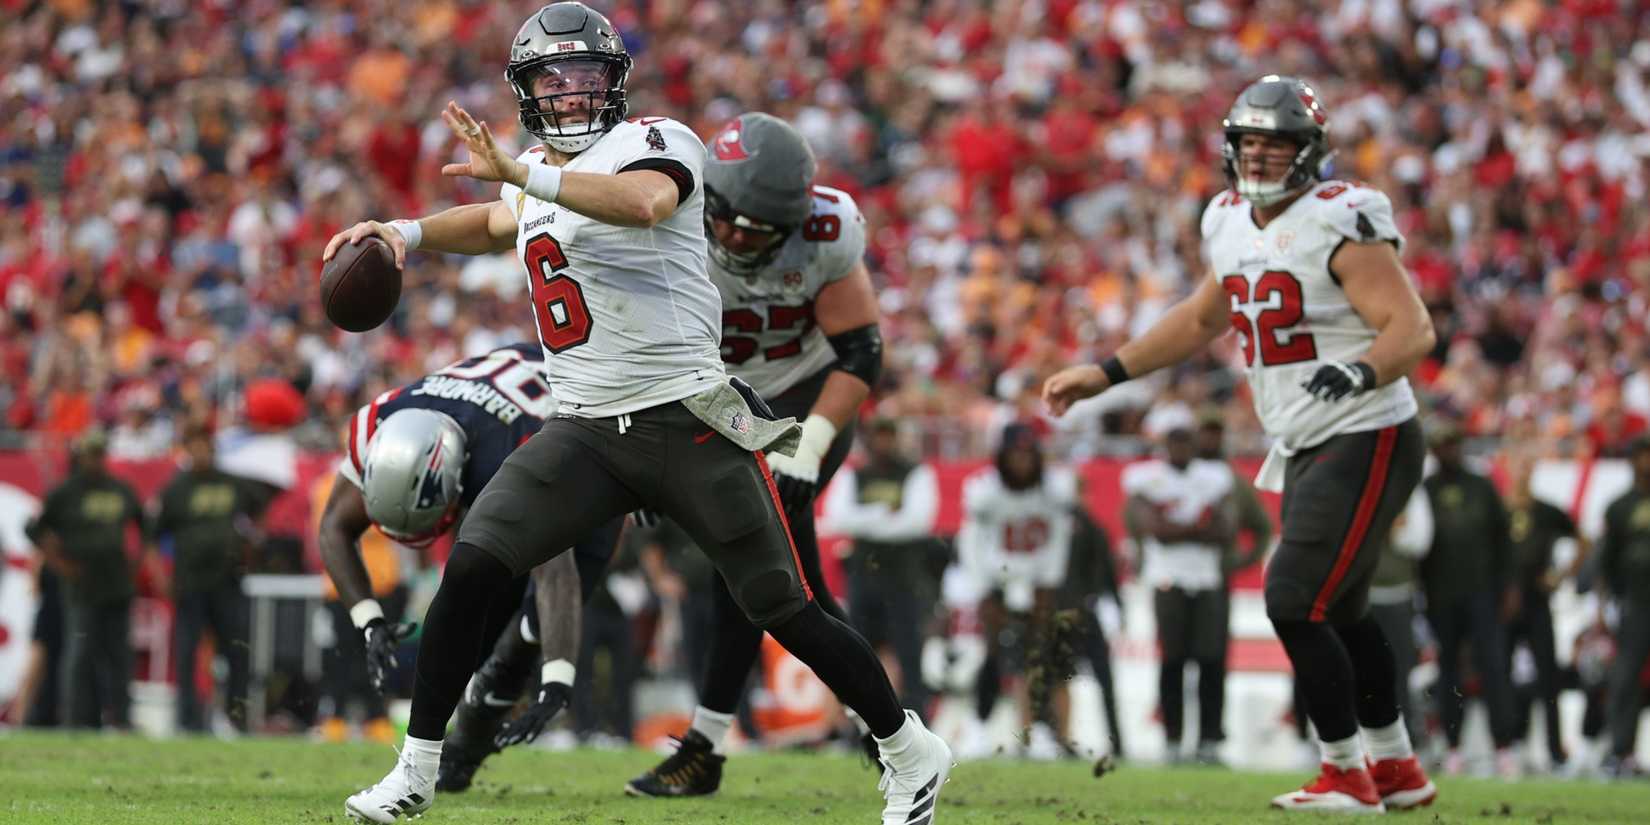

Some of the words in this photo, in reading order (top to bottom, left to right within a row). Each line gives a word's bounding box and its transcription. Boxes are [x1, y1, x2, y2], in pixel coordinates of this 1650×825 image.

[524, 232, 594, 355] 6
[722, 298, 818, 366] 67
[1223, 269, 1318, 367] 62
[411, 374, 524, 426] BARMORE
